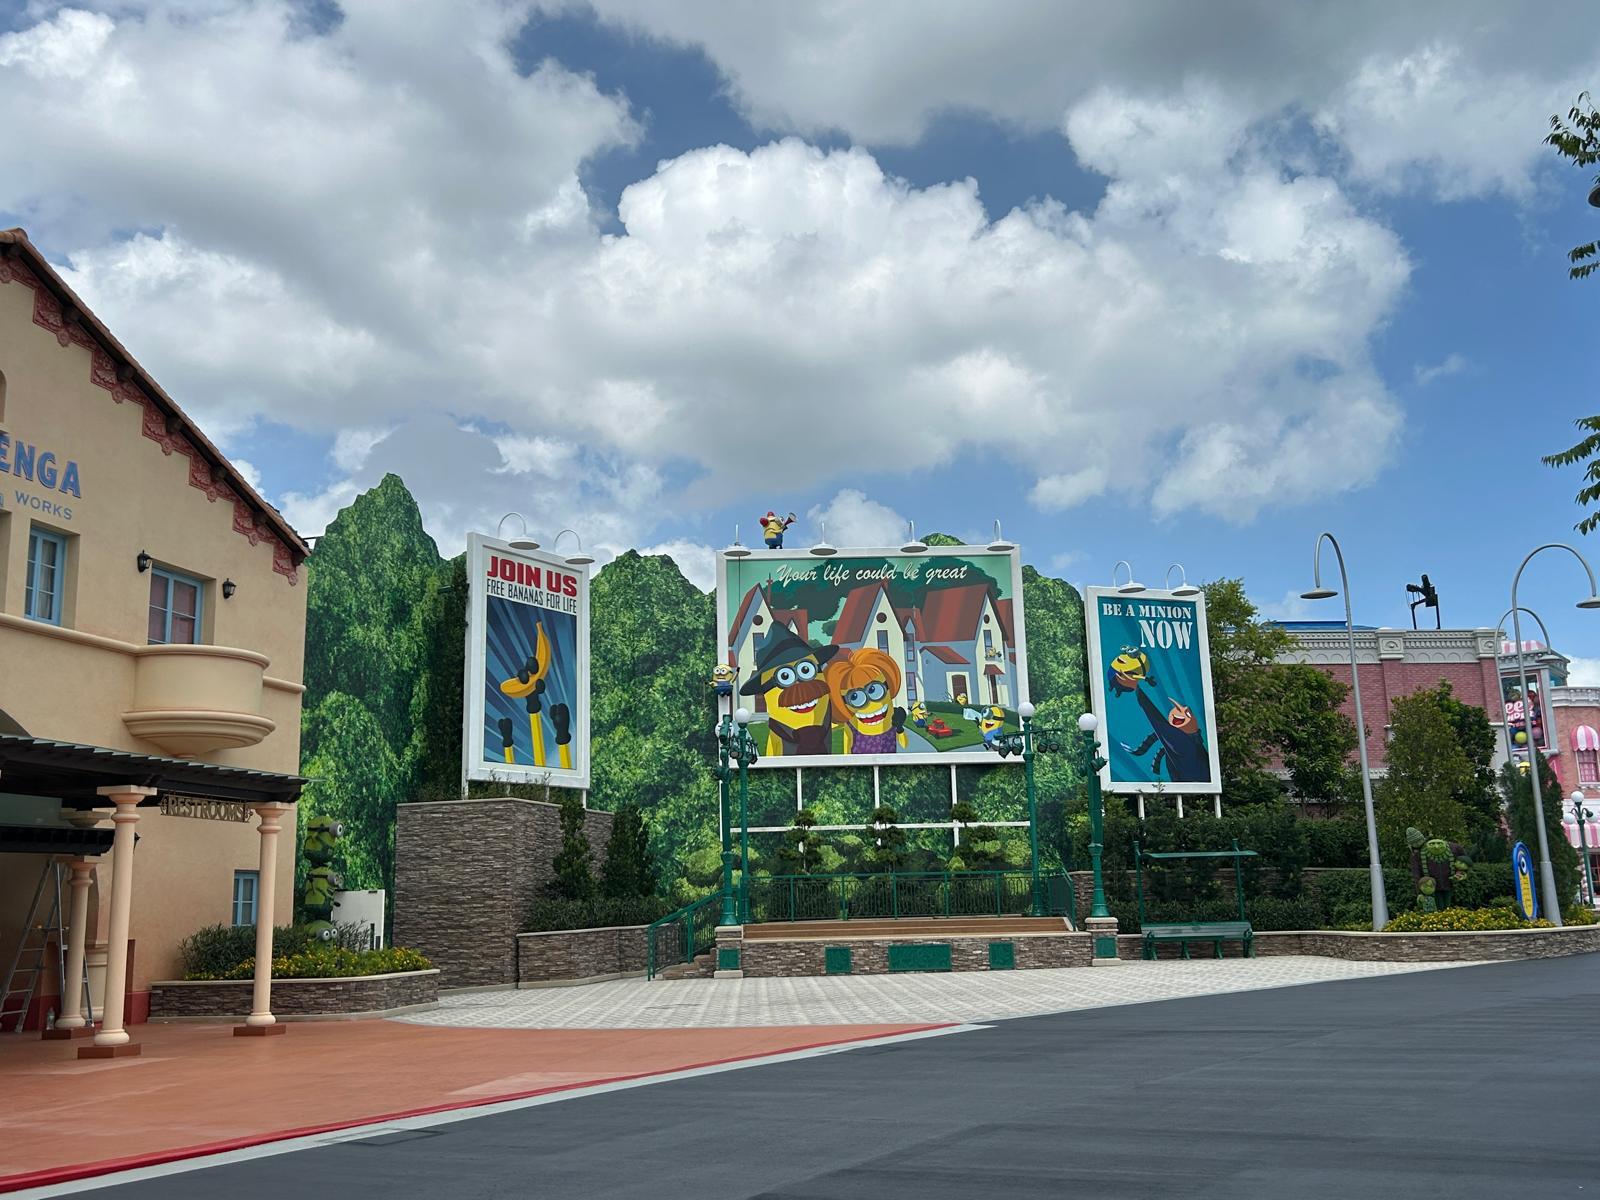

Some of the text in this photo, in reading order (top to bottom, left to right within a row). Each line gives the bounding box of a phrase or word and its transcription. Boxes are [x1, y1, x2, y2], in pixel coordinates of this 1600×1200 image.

[15, 490, 72, 520] WORKS
[486, 556, 578, 597] JOIN US
[776, 562, 968, 588] Your life could be great
[486, 578, 578, 614] FREE BANANAS FOR LIFE
[1102, 603, 1192, 619] BE A MINION
[1138, 619, 1193, 650] NOW
[168, 796, 244, 822] RESTROOMS
